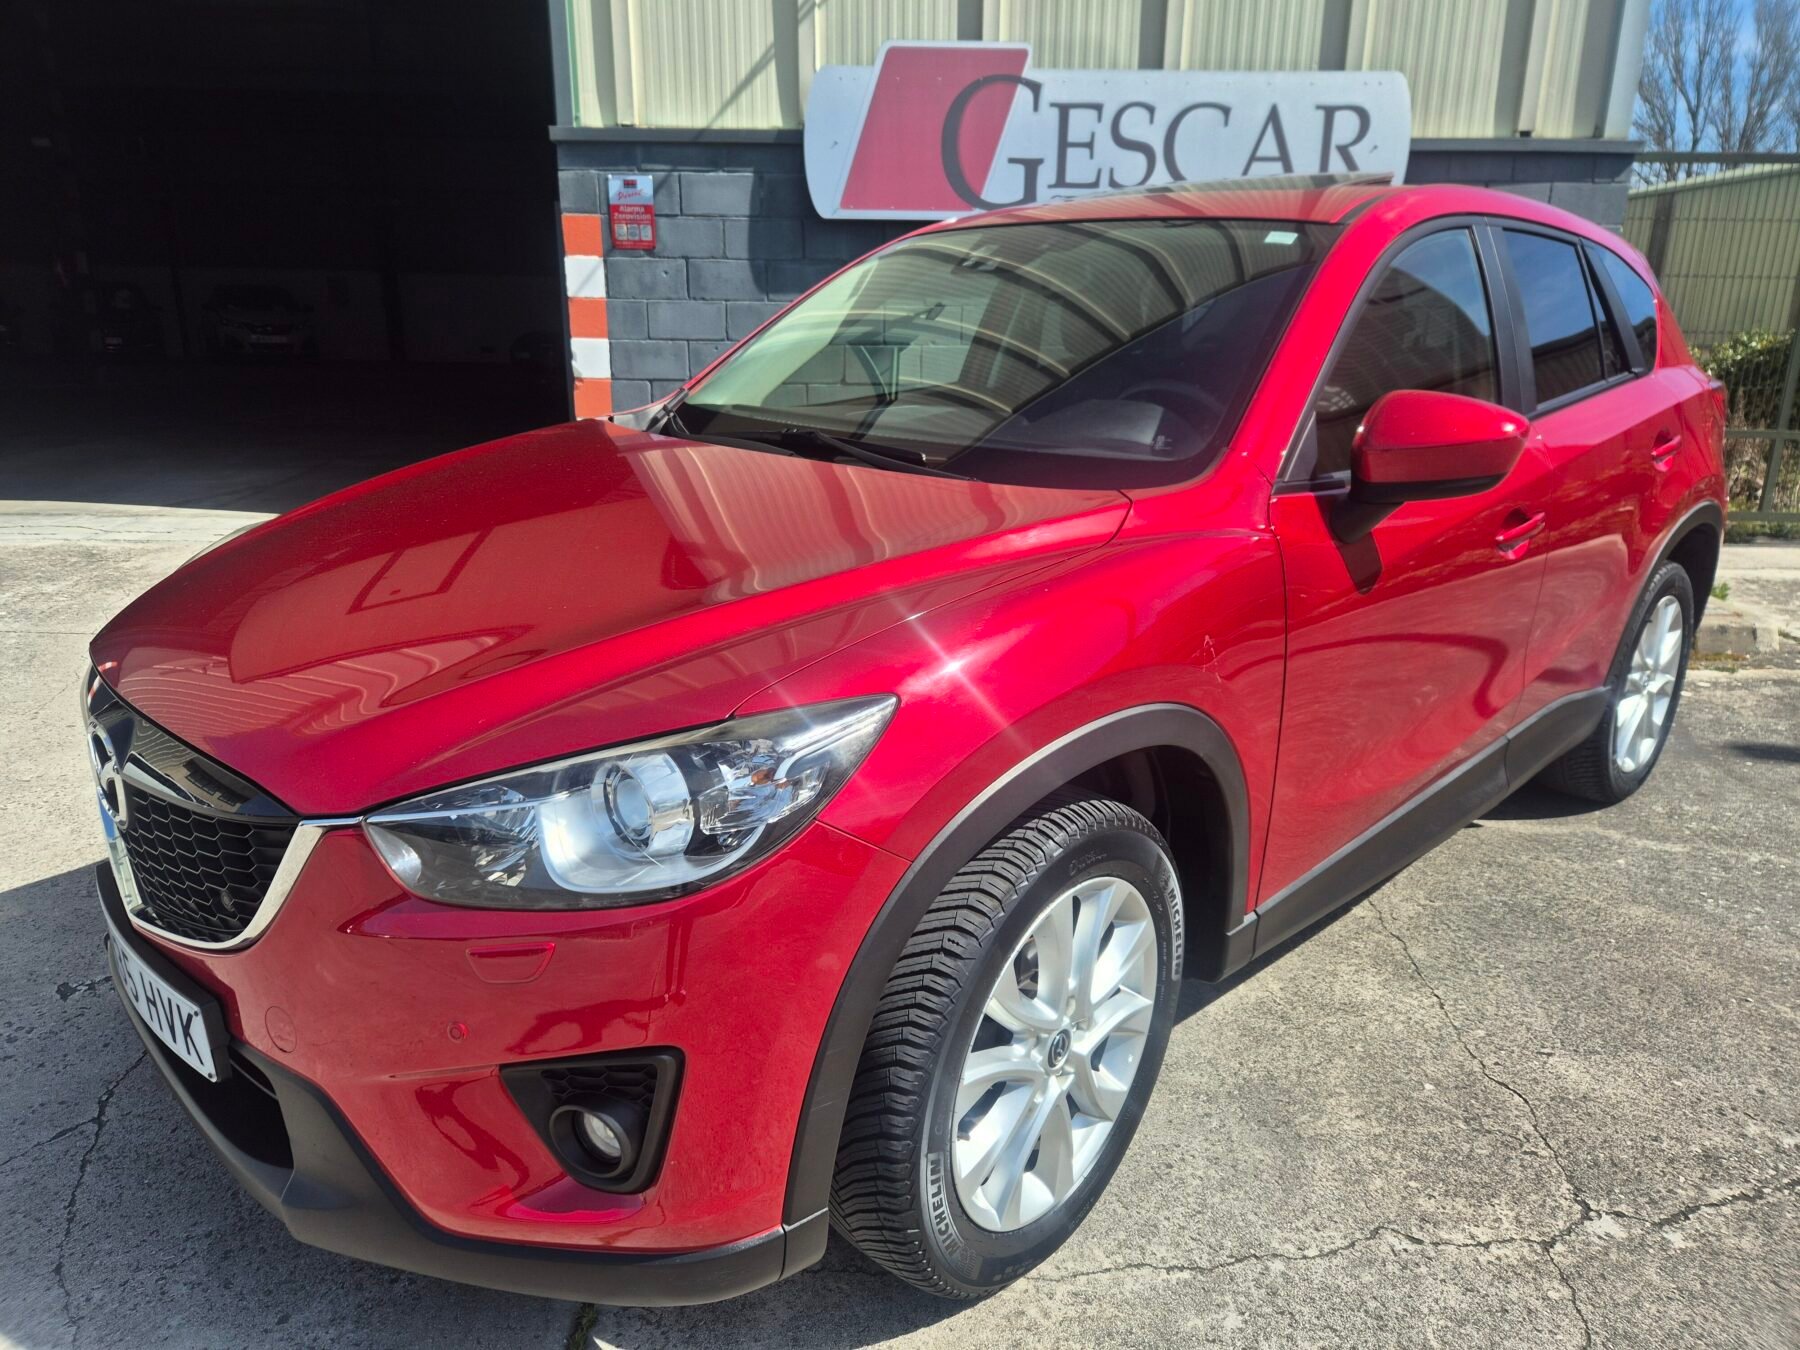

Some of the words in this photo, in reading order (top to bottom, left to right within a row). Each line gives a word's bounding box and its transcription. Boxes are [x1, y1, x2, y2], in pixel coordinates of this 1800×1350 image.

[940, 73, 1372, 209] GESCAR
[1167, 887, 1183, 976] MICHELIN
[138, 970, 205, 1067] HVK
[929, 1159, 962, 1258] MICHELIN
